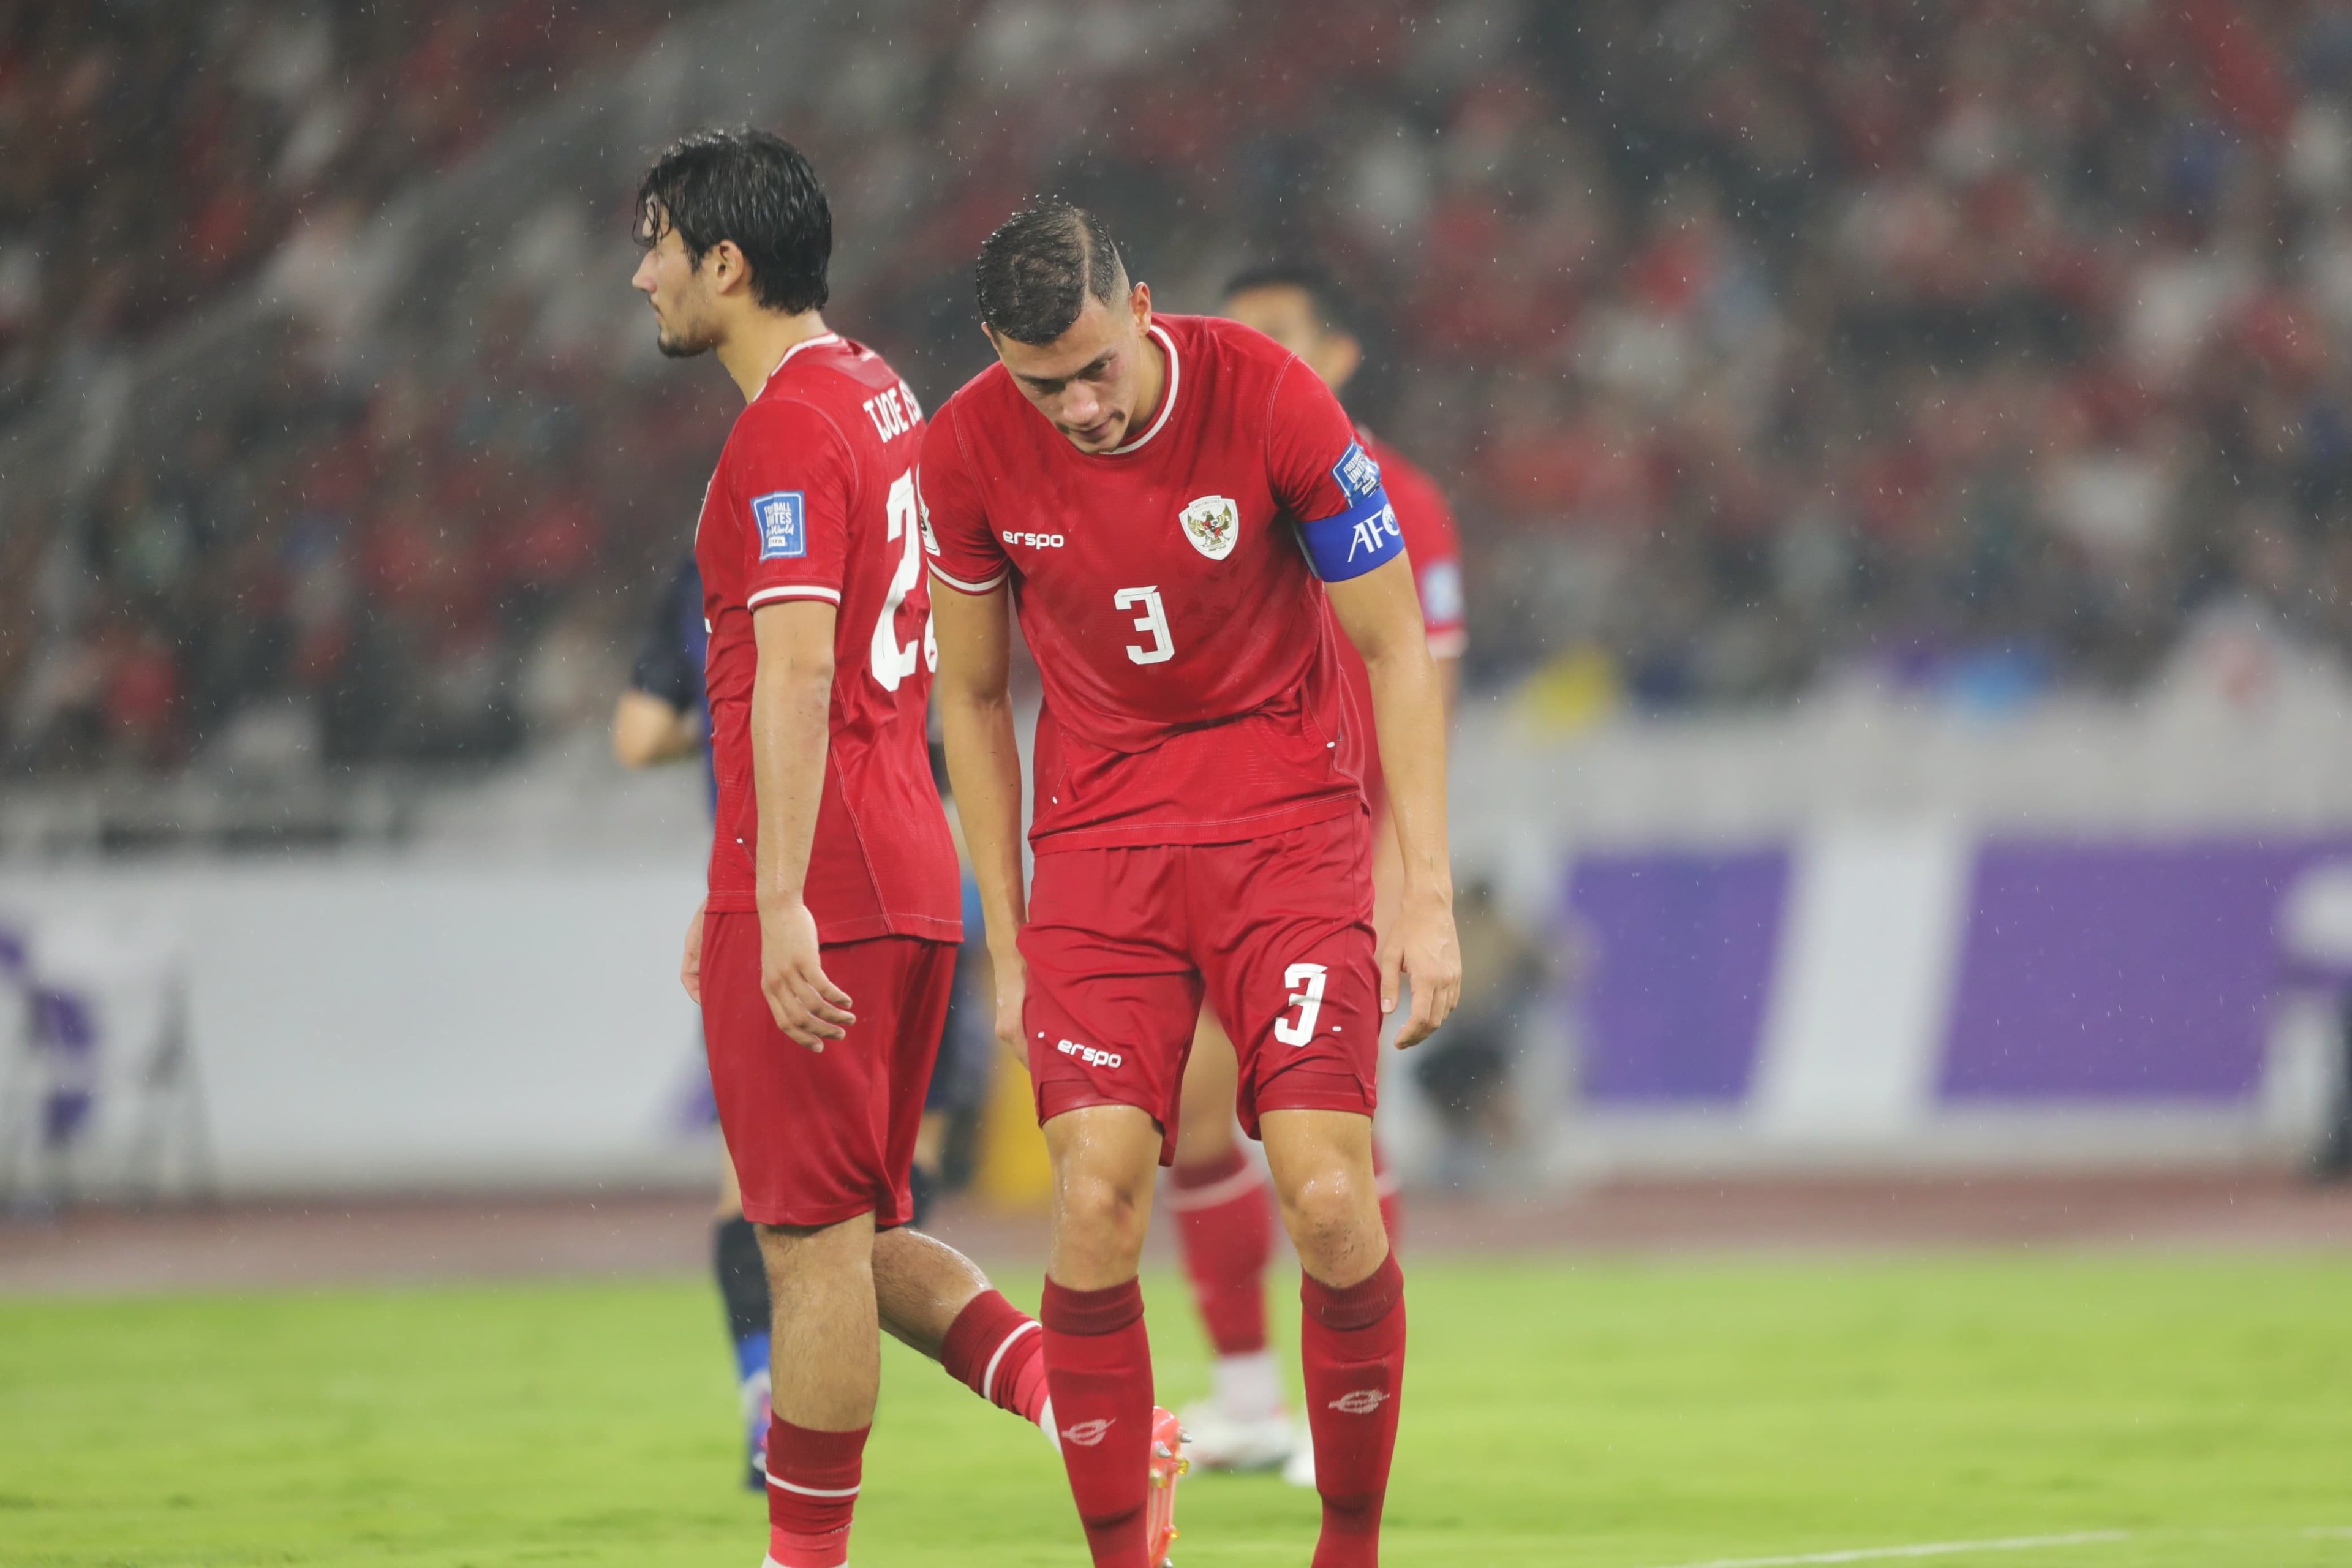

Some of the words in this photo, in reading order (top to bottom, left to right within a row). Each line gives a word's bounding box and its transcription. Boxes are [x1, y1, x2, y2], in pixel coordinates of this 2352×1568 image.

[862, 386, 910, 443] TJOE
[764, 502, 791, 514] FOBALL
[1348, 503, 1400, 562] AFC
[1003, 530, 1064, 550] erspo
[1114, 585, 1175, 665] 3
[1274, 963, 1328, 1047] 3
[1057, 1039, 1122, 1068] erspo
